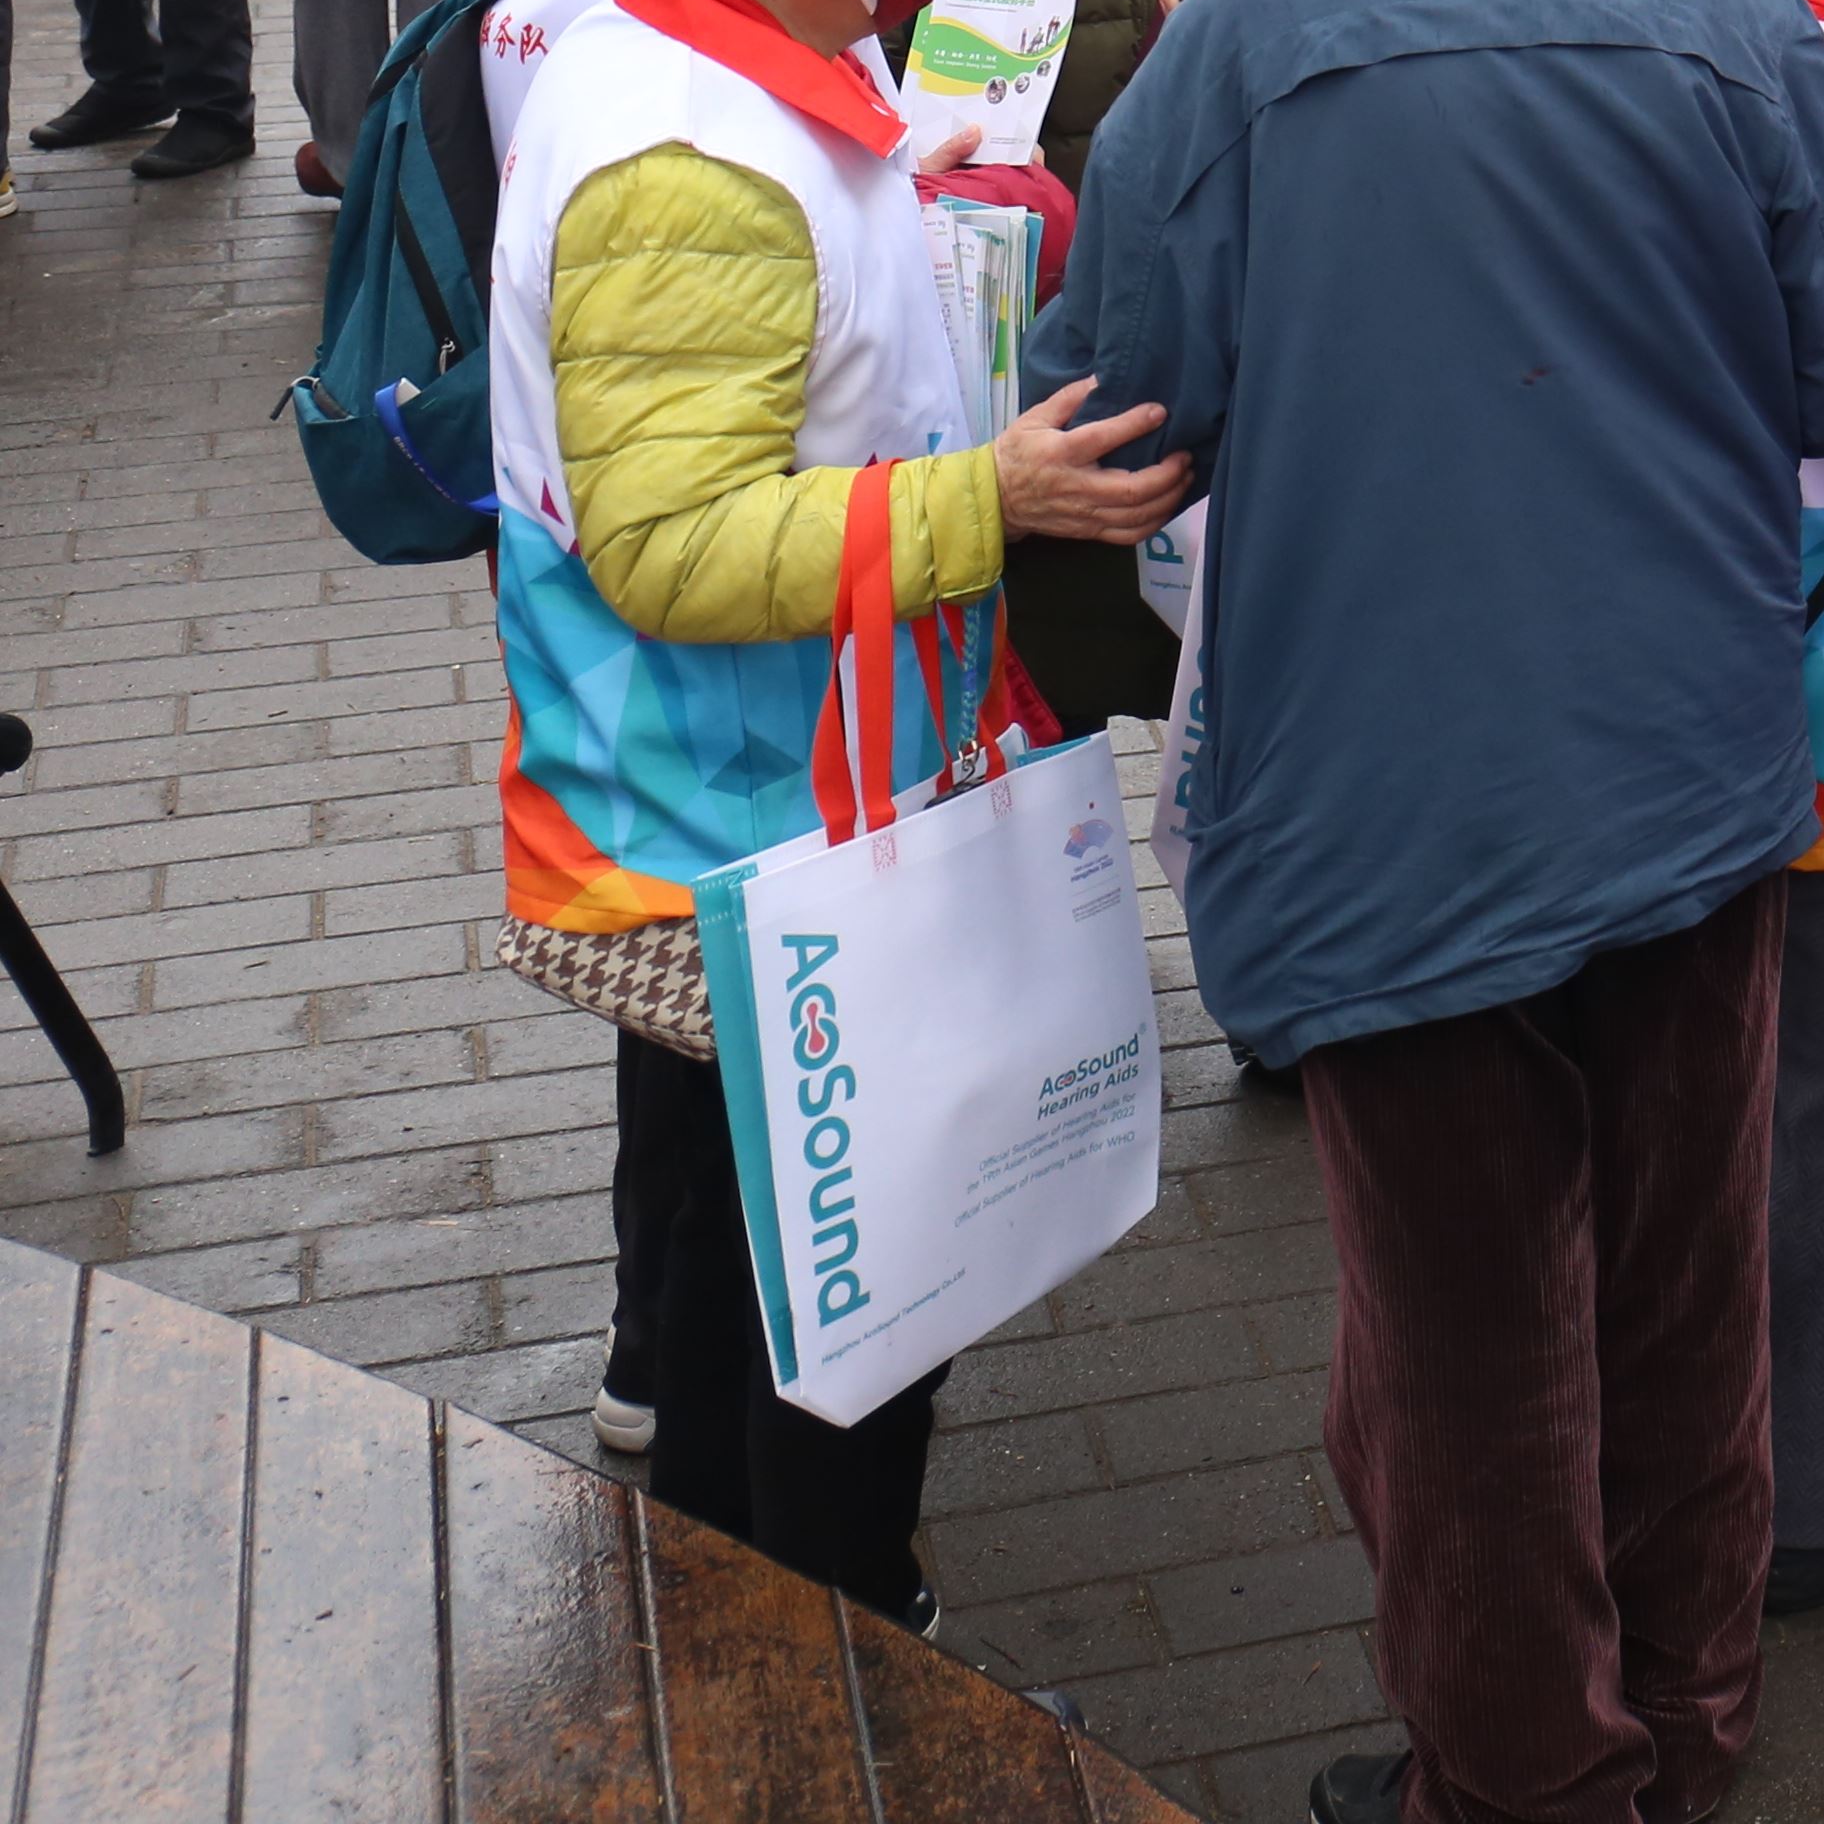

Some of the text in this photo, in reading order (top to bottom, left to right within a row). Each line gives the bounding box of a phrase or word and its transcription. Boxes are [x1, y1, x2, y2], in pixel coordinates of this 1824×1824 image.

[1036, 1063, 1139, 1120] Hearing Aids
[1122, 1092, 1136, 1104] for
[1110, 1105, 1136, 1123] 2022
[1067, 1147, 1087, 1163] Aids
[1089, 1140, 1103, 1154] for
[1105, 1131, 1136, 1148] WHO
